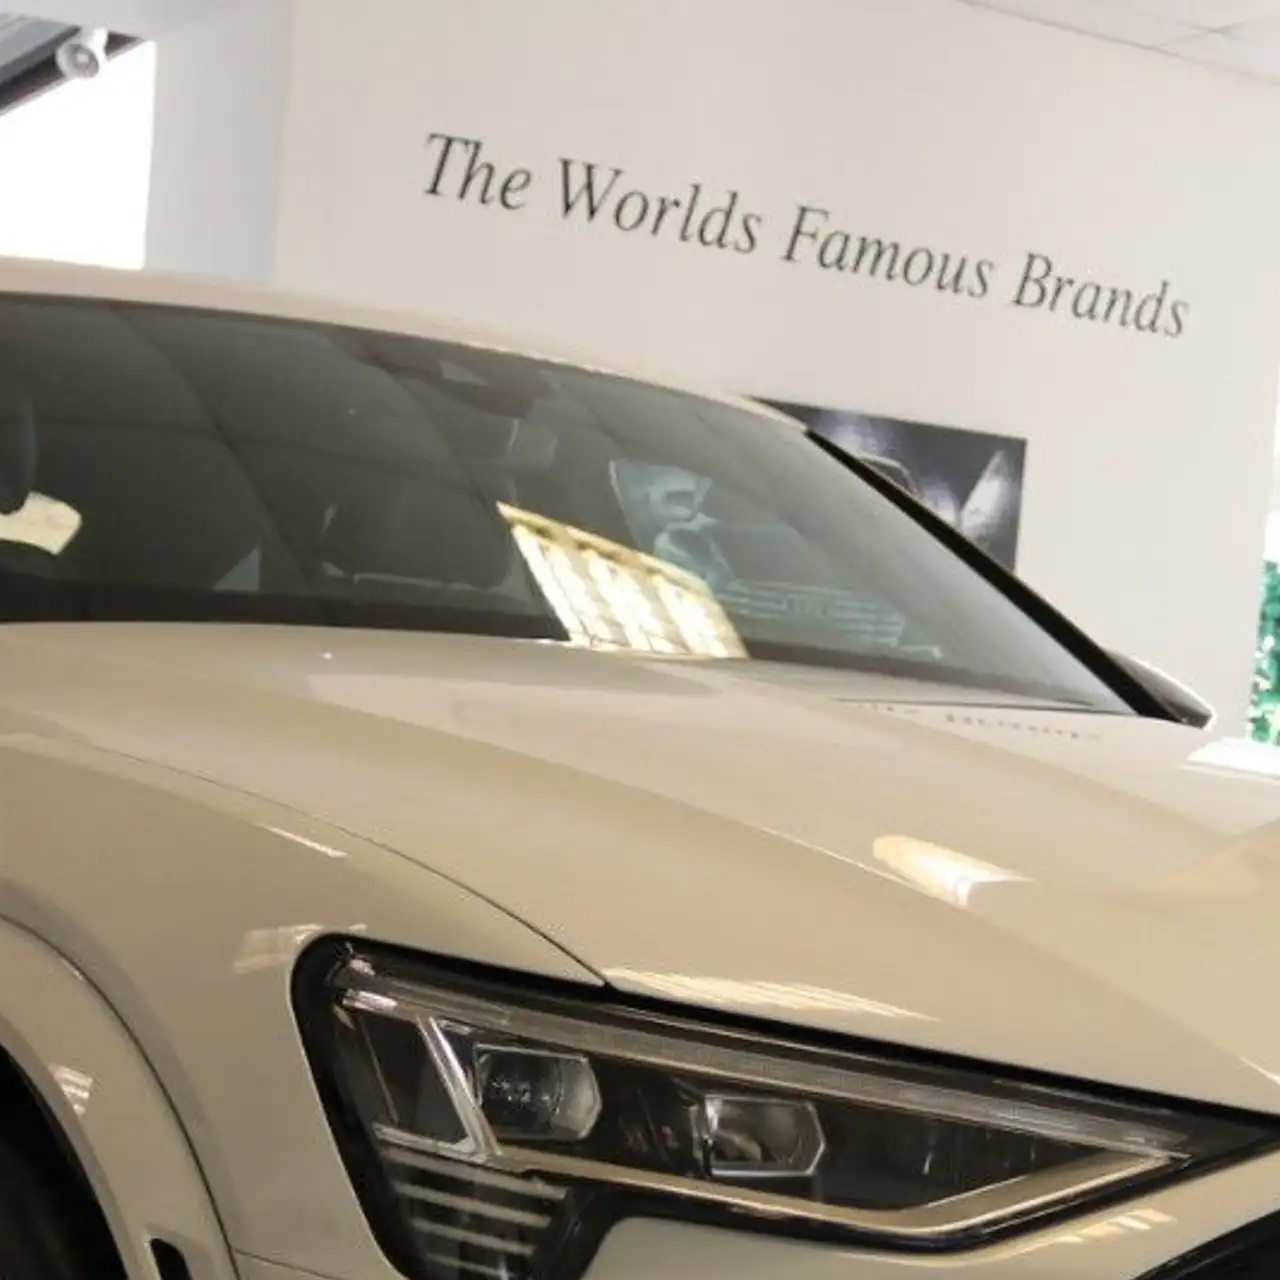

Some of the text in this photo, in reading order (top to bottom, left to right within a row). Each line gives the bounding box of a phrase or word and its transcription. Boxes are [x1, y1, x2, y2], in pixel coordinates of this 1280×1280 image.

[423, 131, 1192, 340] The Worlds Famous Brands
